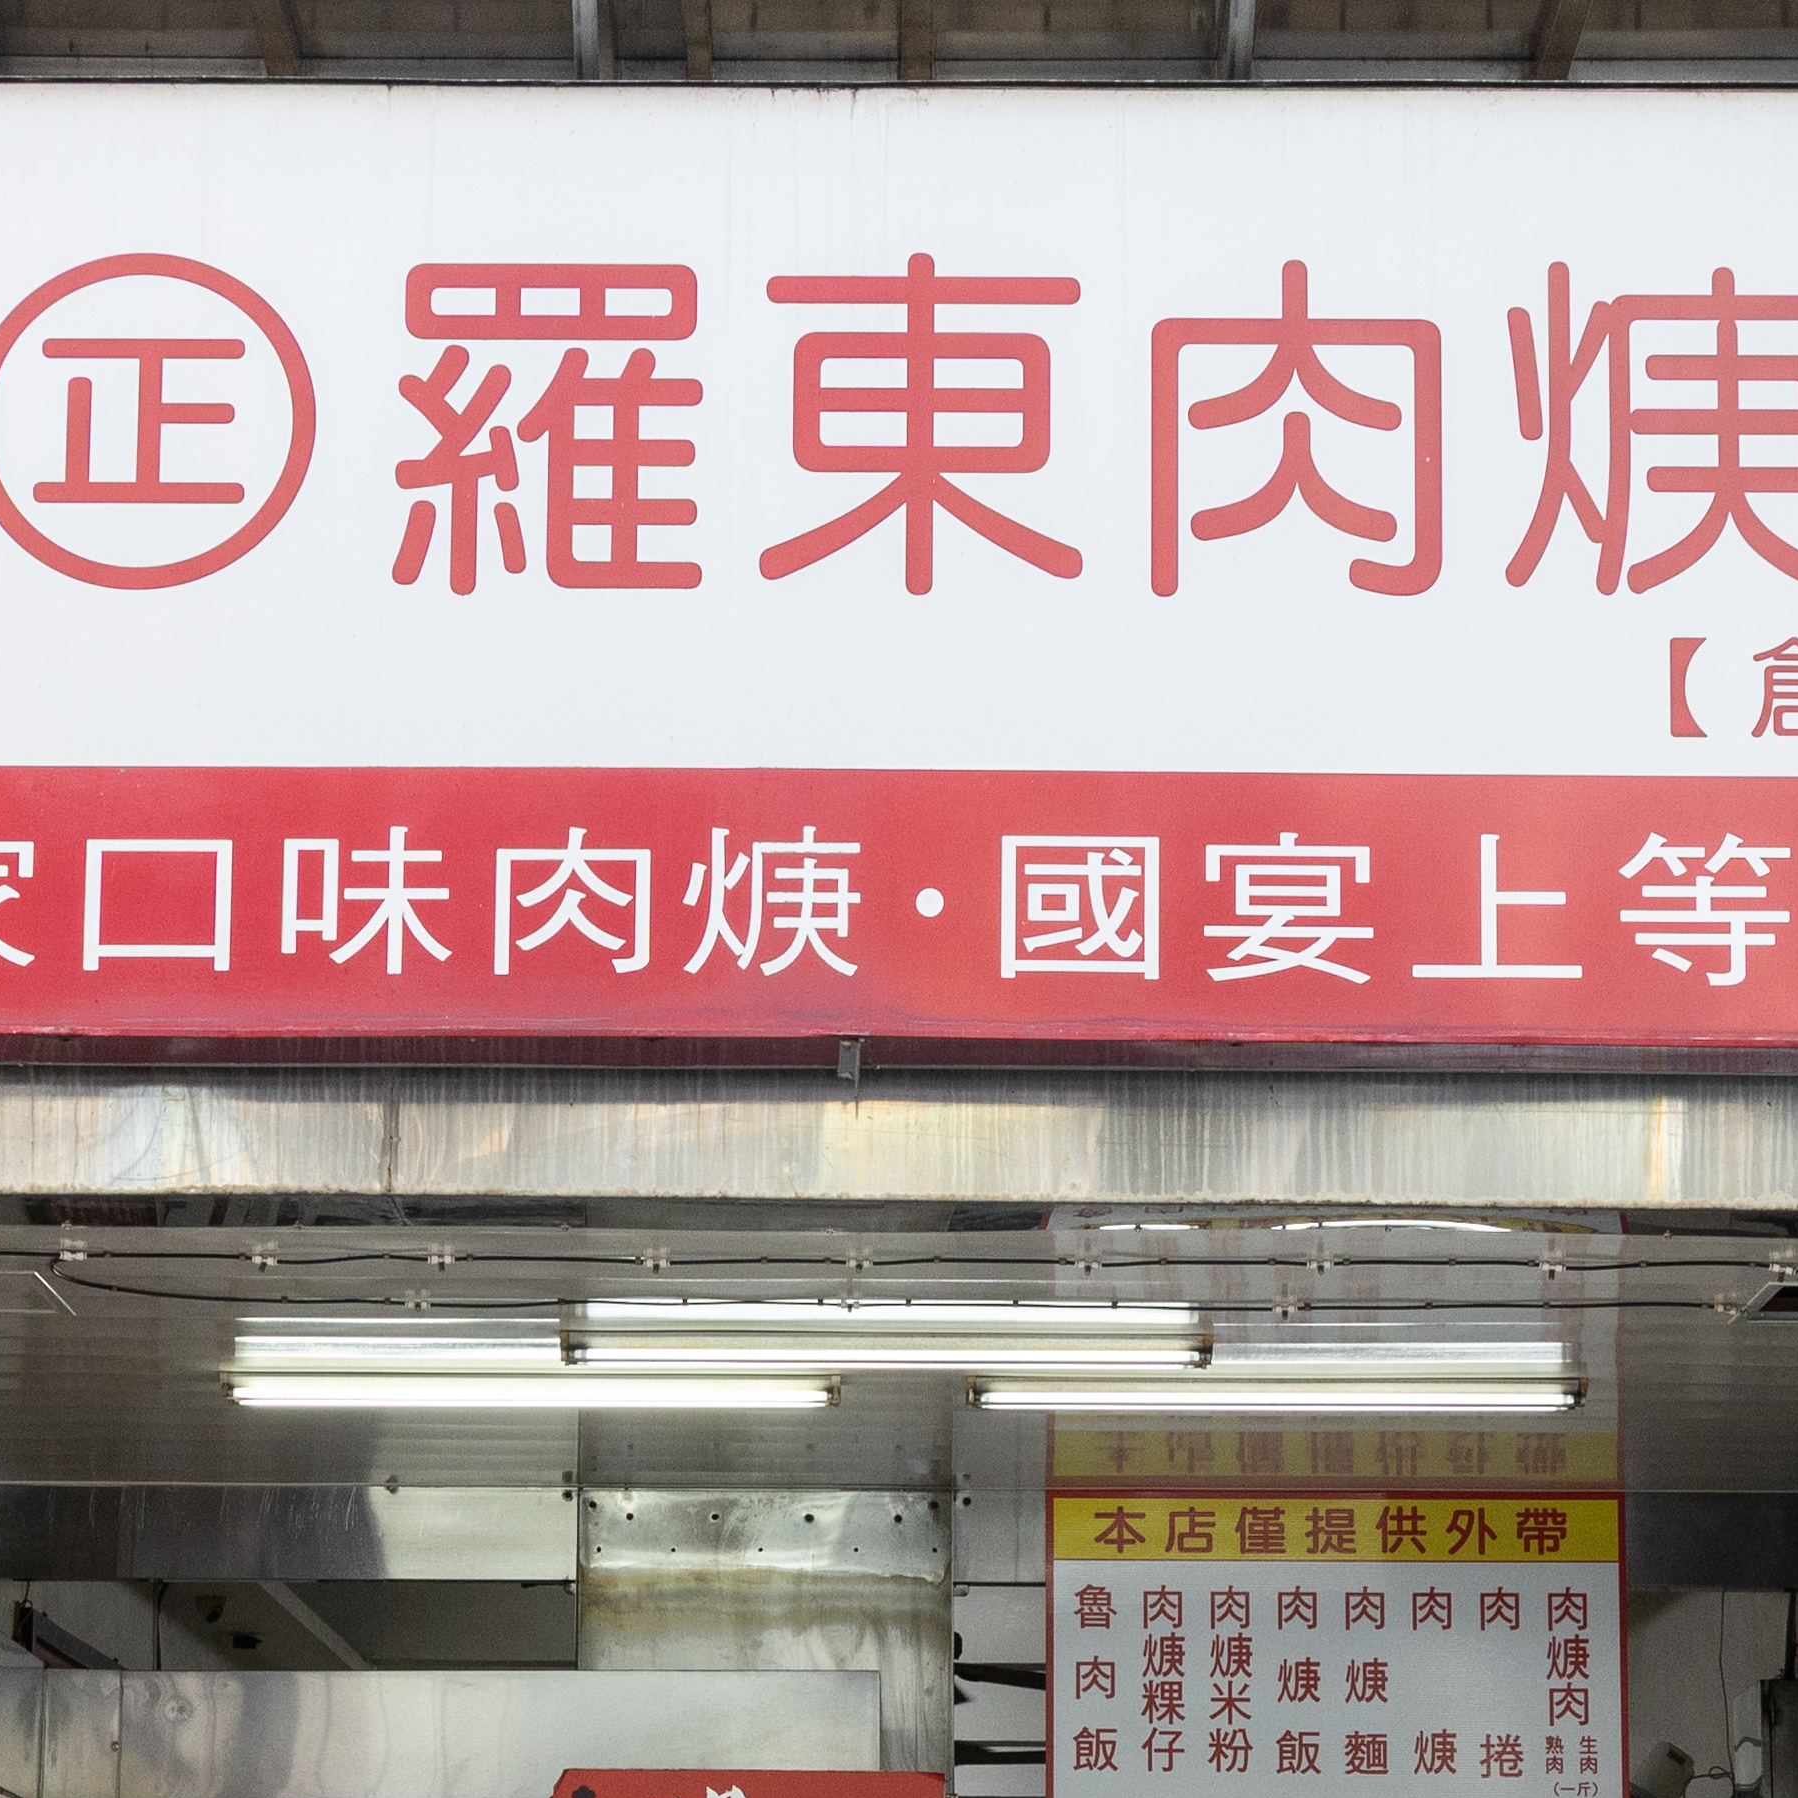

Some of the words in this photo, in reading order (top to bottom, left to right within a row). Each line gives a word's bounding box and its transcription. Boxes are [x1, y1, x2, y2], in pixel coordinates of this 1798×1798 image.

[1094, 1506, 1568, 1556] 本店僅提供外帶
